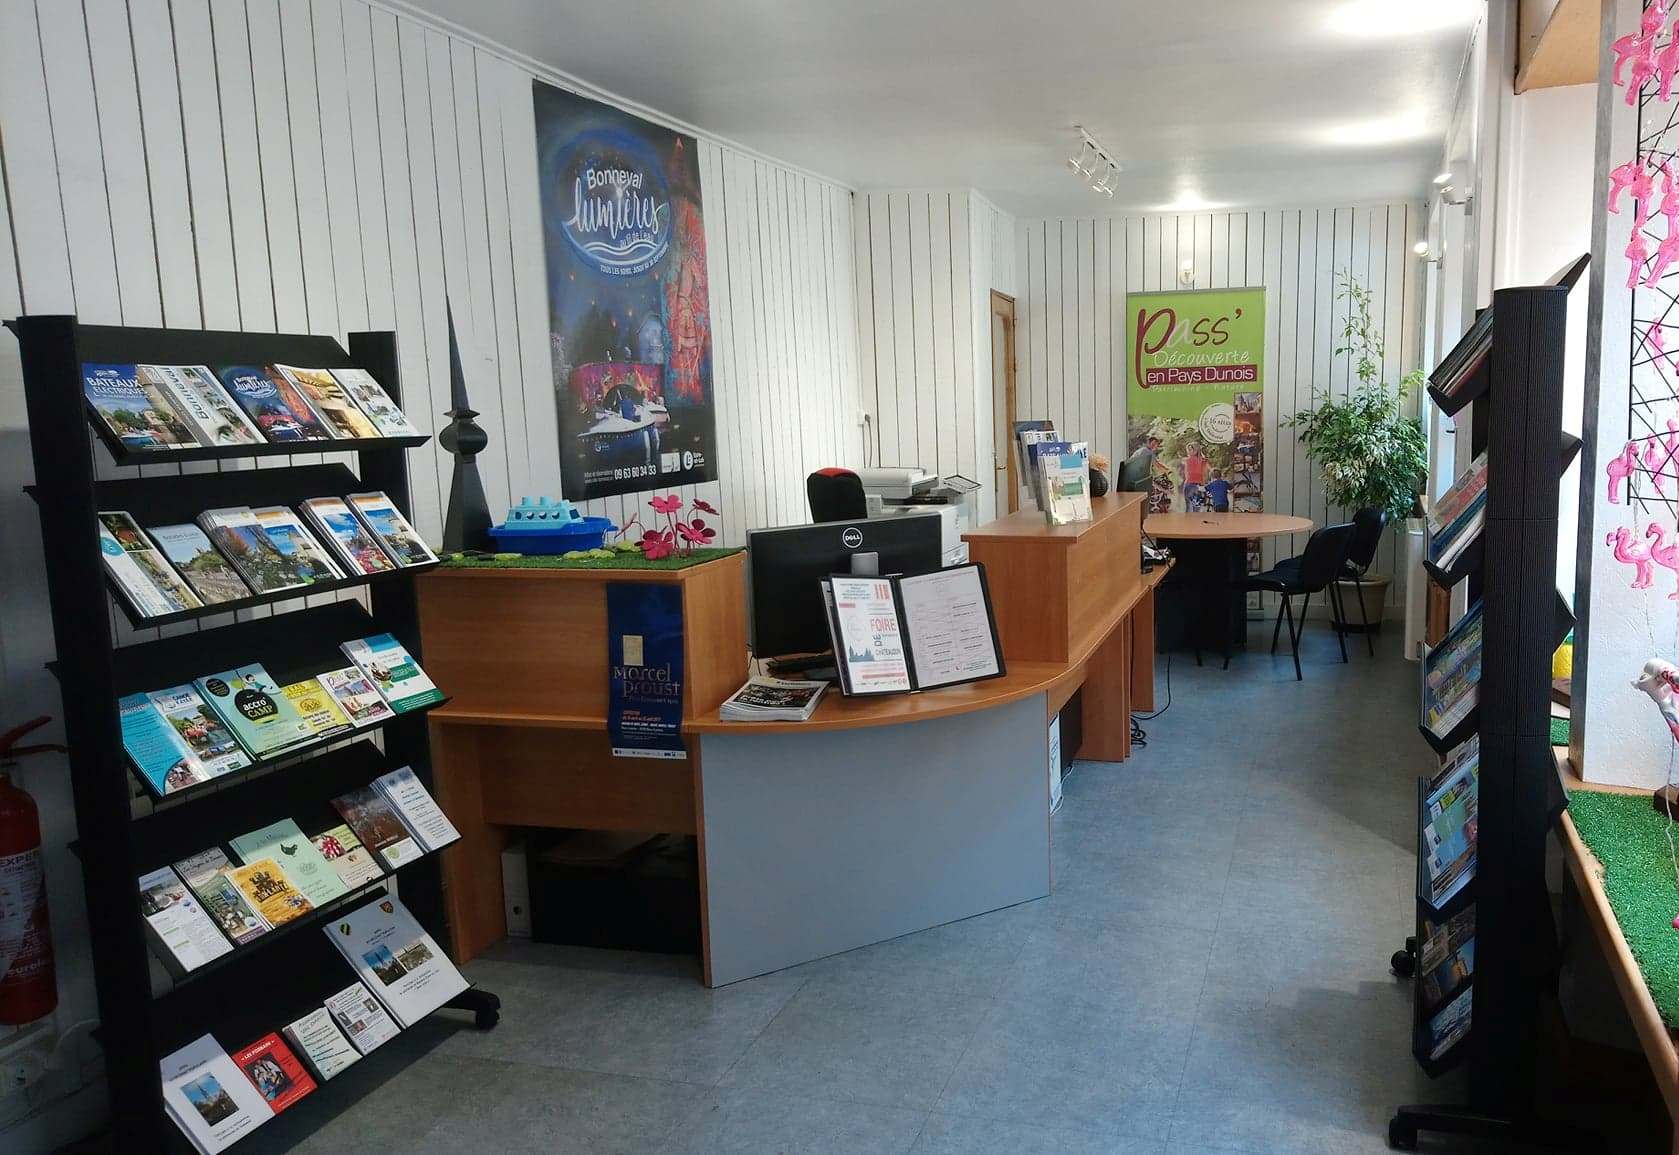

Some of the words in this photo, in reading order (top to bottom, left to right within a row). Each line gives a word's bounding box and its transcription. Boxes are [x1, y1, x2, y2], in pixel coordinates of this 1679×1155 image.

[586, 168, 643, 190] Bonneval
[567, 176, 668, 240] lumières
[1135, 308, 1243, 389] Pass'
[1154, 350, 1249, 367] Découverte
[86, 377, 142, 388] BATEAUX
[1147, 371, 1165, 383] en
[1168, 368, 1202, 385] Pays
[1204, 366, 1254, 381] Dunois
[614, 468, 623, 480] 09
[623, 468, 631, 478] 63
[640, 466, 648, 476] 34
[648, 465, 656, 475] 33
[871, 618, 897, 632] FOIRE
[247, 704, 273, 718] CAMP
